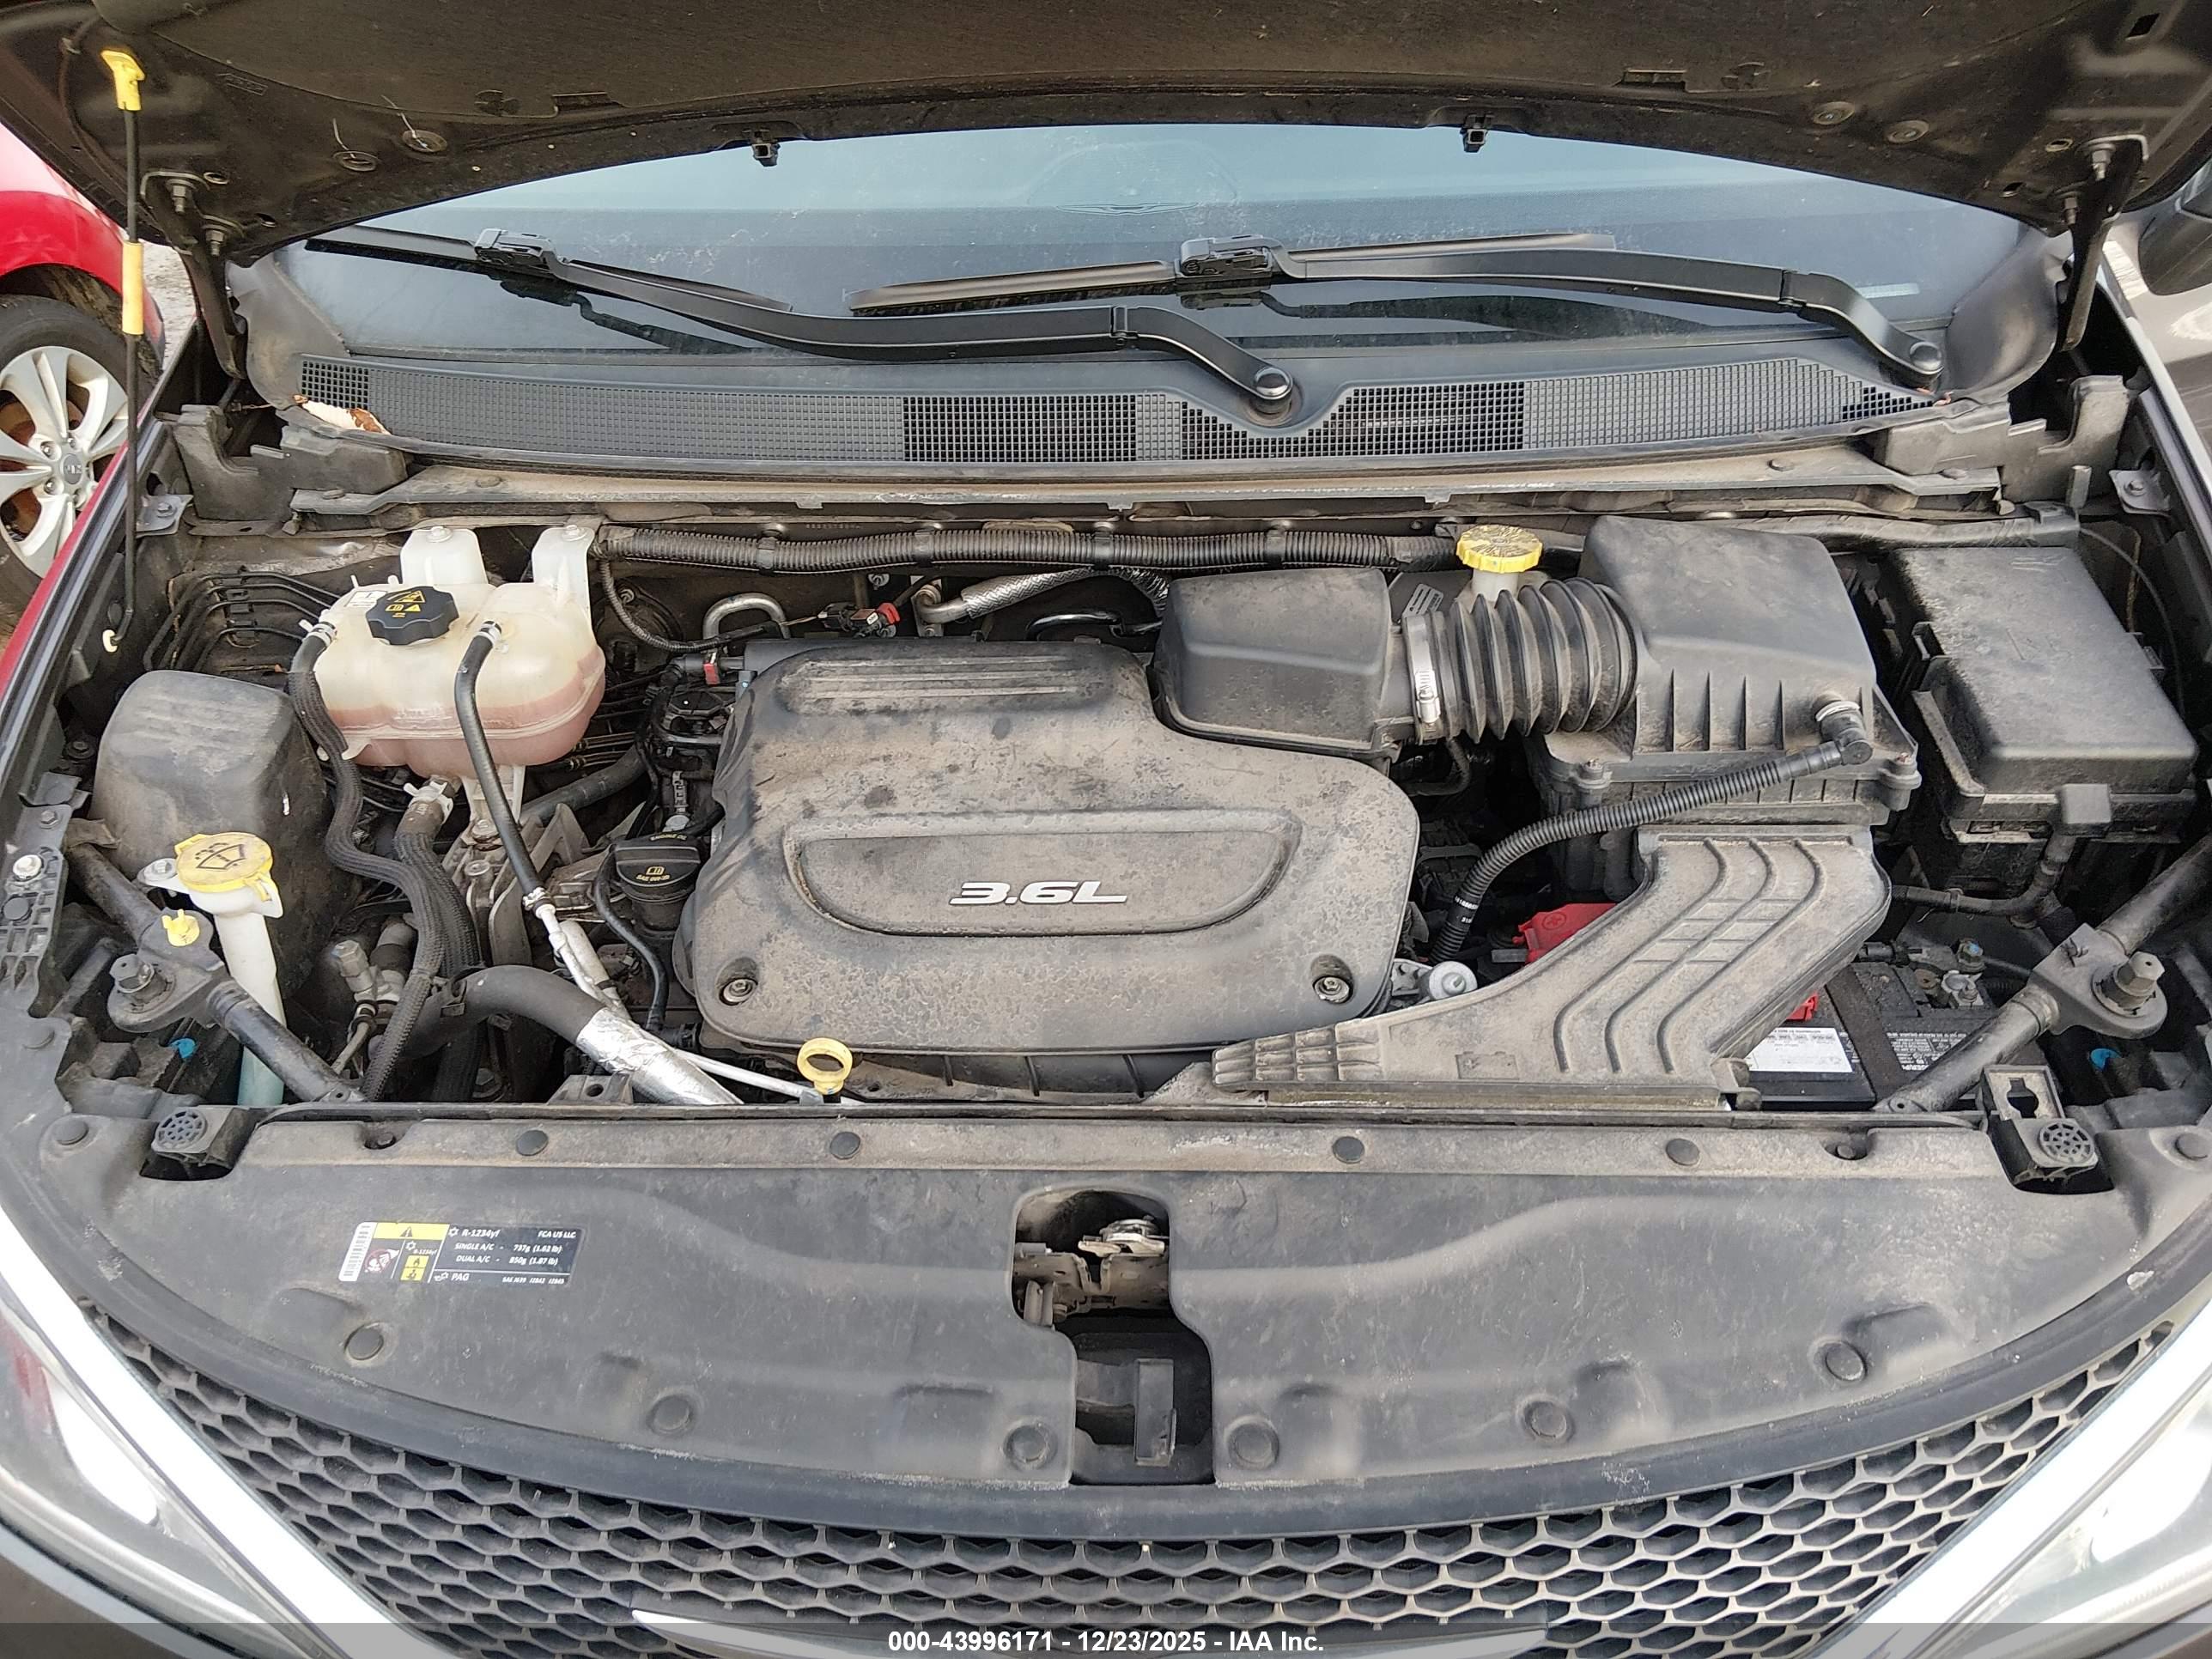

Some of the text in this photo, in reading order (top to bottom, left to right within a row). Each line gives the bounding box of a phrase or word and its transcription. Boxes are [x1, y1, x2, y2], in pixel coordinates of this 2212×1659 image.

[949, 880, 1127, 905] 3.6L
[461, 1229, 501, 1239] R-1234yf
[538, 1230, 552, 1238] FCA
[563, 1231, 577, 1239] LLC
[454, 1242, 480, 1250] SINGLE
[480, 1243, 495, 1251] A/C
[455, 1255, 476, 1263] DUAL
[475, 1255, 491, 1264] A/C
[451, 1272, 471, 1281] PAG
